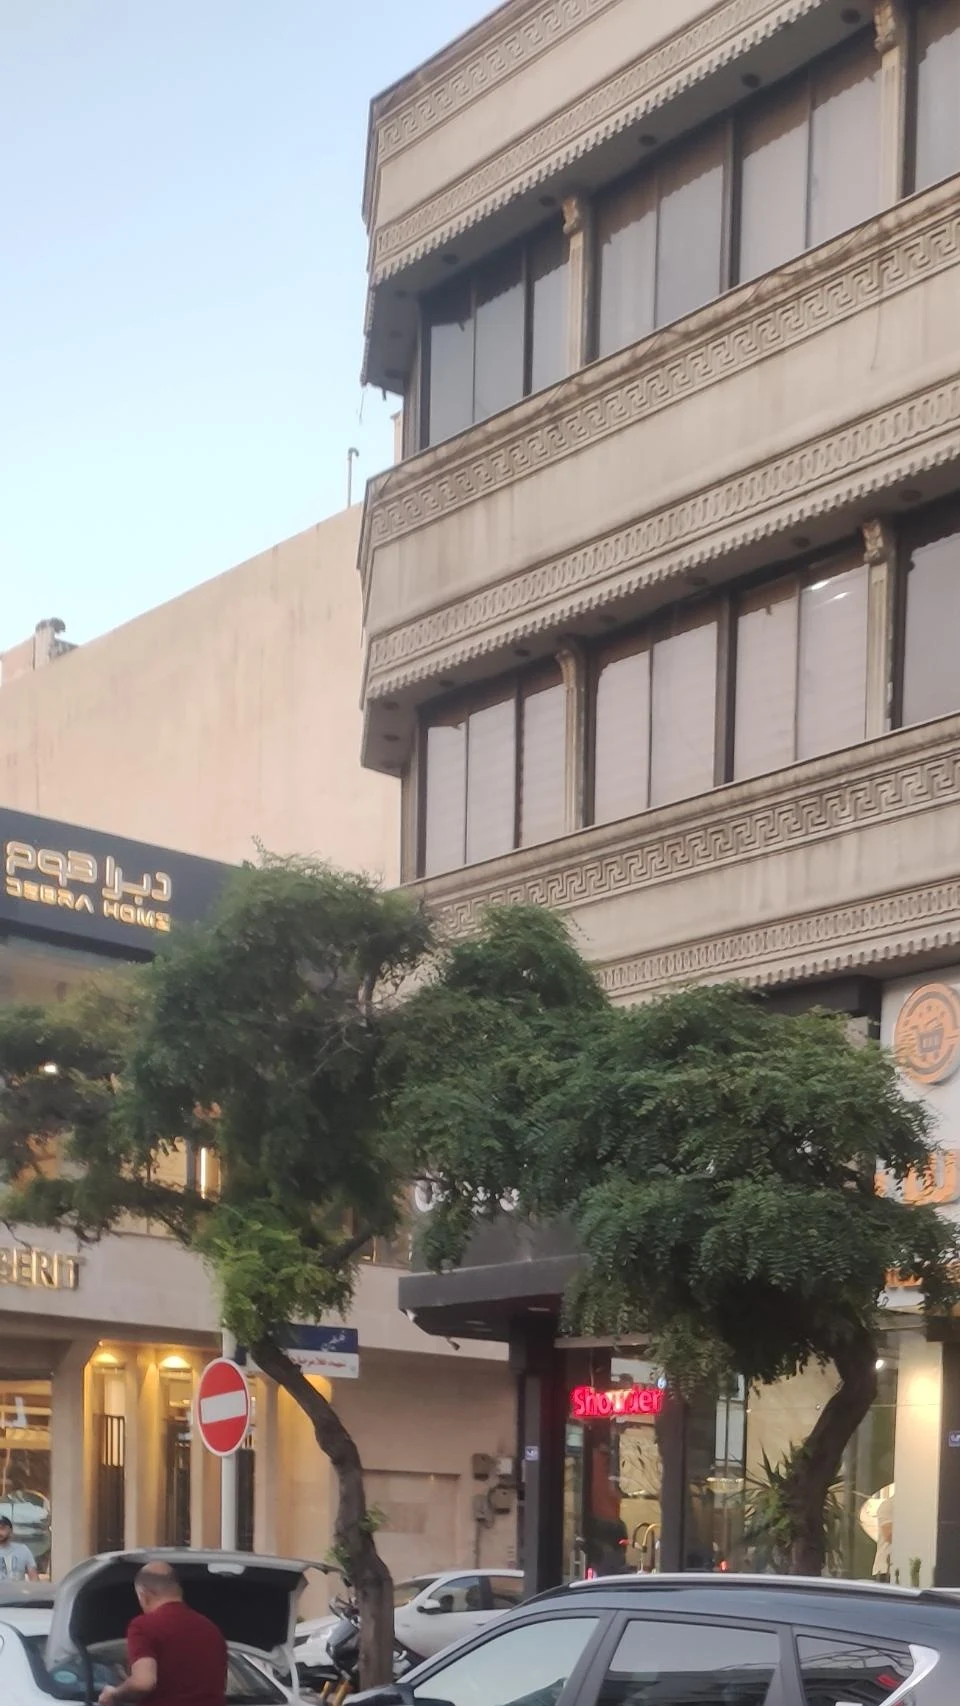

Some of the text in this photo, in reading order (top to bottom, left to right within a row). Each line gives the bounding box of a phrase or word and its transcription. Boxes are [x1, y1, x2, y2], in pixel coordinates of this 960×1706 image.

[6, 841, 172, 906] دبرا هوم
[103, 899, 171, 932] HOME
